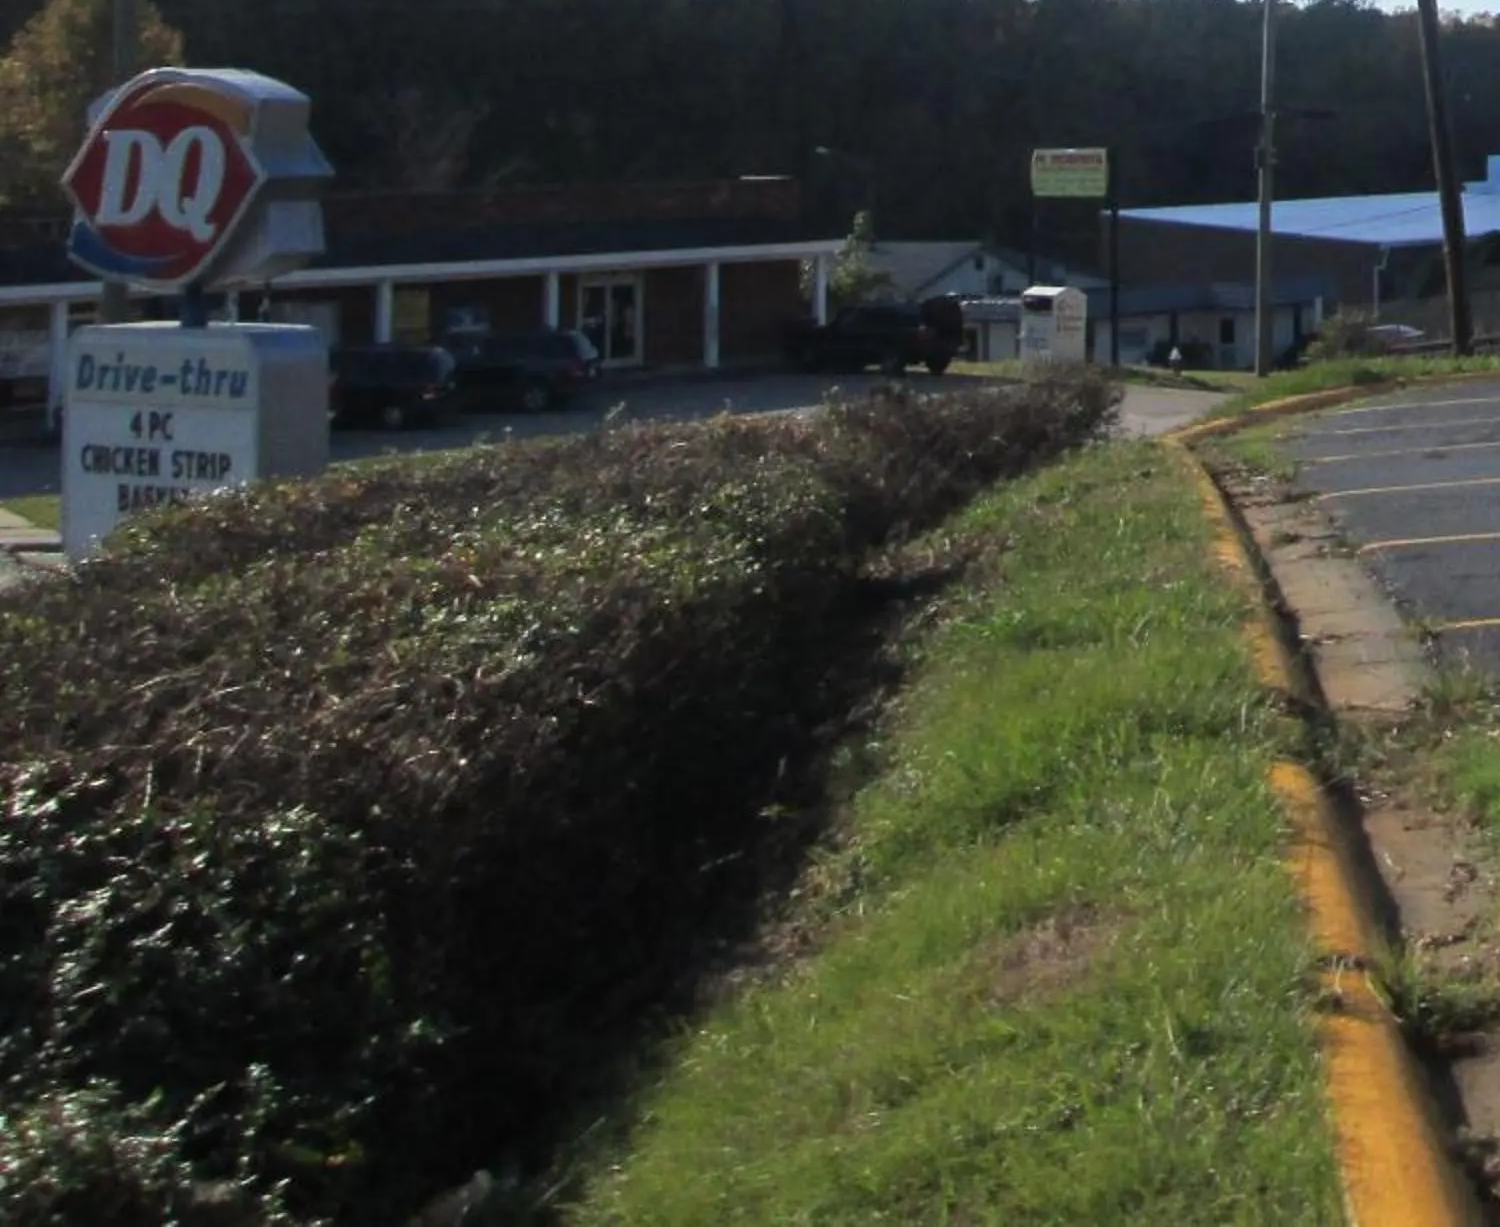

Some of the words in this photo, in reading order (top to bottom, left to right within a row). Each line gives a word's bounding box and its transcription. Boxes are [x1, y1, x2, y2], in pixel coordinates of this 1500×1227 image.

[95, 125, 227, 244] DQ
[75, 351, 249, 399] Drive-thru
[129, 410, 143, 440] 4
[148, 410, 174, 441] PC
[81, 444, 161, 477] CHICKEN
[171, 450, 232, 480] STRIP
